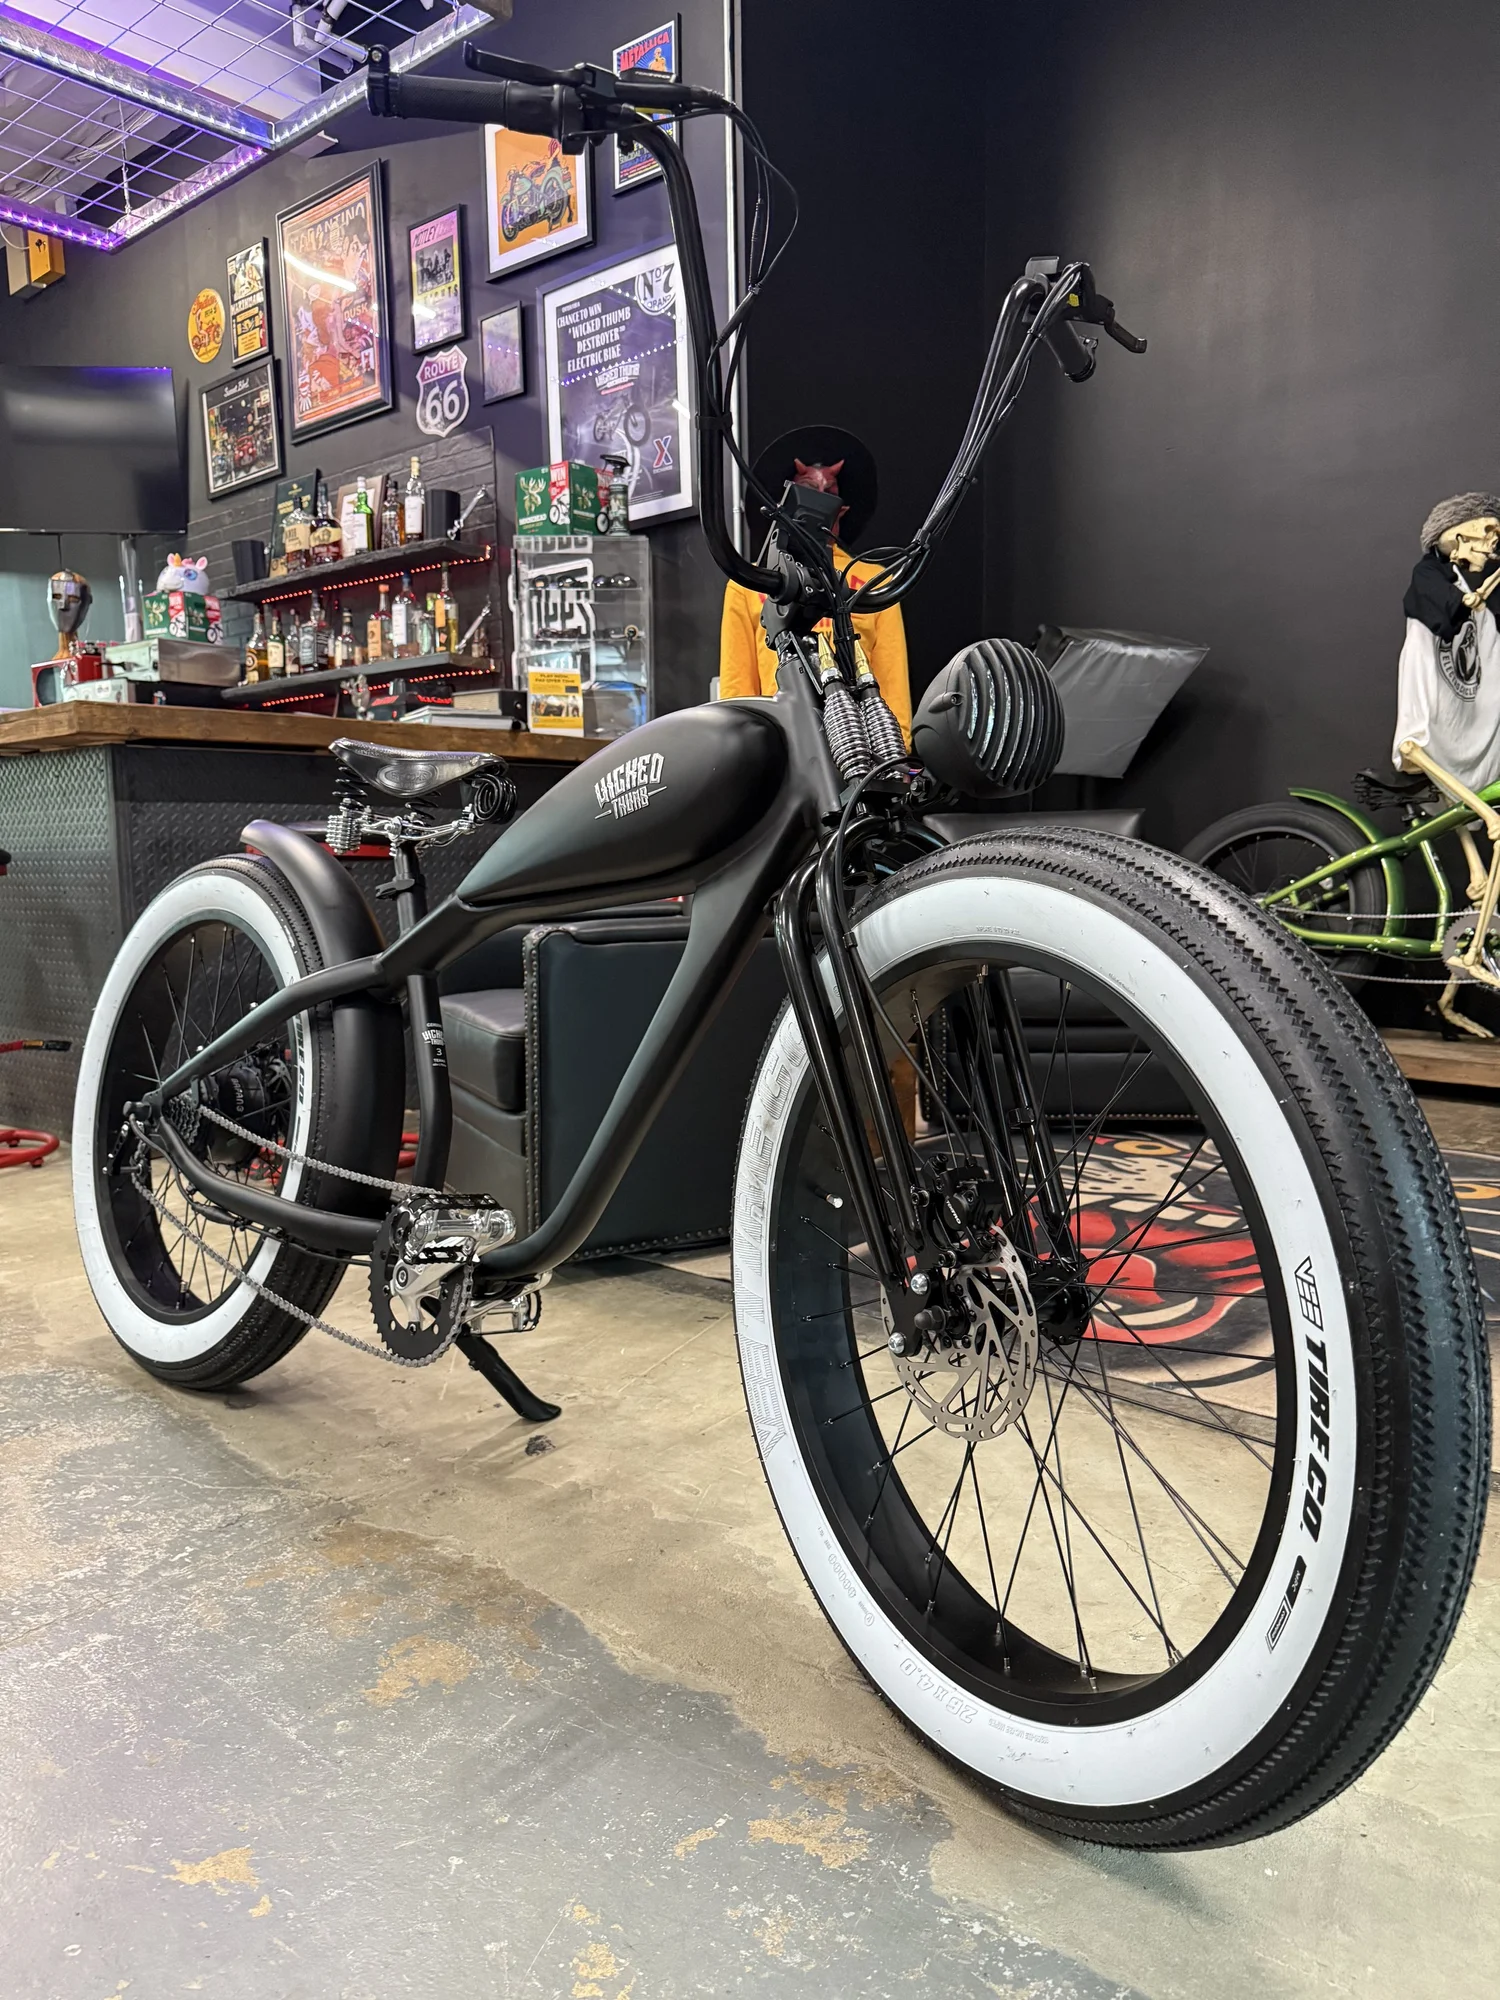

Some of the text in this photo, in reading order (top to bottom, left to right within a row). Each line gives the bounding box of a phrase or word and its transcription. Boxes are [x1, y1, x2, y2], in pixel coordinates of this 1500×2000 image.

[619, 31, 670, 72] METALLICA
[343, 302, 369, 322] DUSK
[557, 310, 581, 328] CHANCE
[580, 307, 589, 321] TO
[589, 302, 602, 317] WIN
[600, 306, 631, 328] THUMB
[424, 355, 459, 380] ROUTE
[567, 344, 621, 373] ELECTRIC BIKE
[425, 379, 460, 425] 66
[550, 466, 567, 483] WIN
[594, 752, 665, 809] WICKED
[611, 786, 650, 820] THUMB
[436, 1047, 443, 1056] 3
[1294, 1255, 1330, 1544] VEE TIRE CO.
[899, 1657, 935, 1691] 4.0
[945, 1696, 978, 1724] 26
